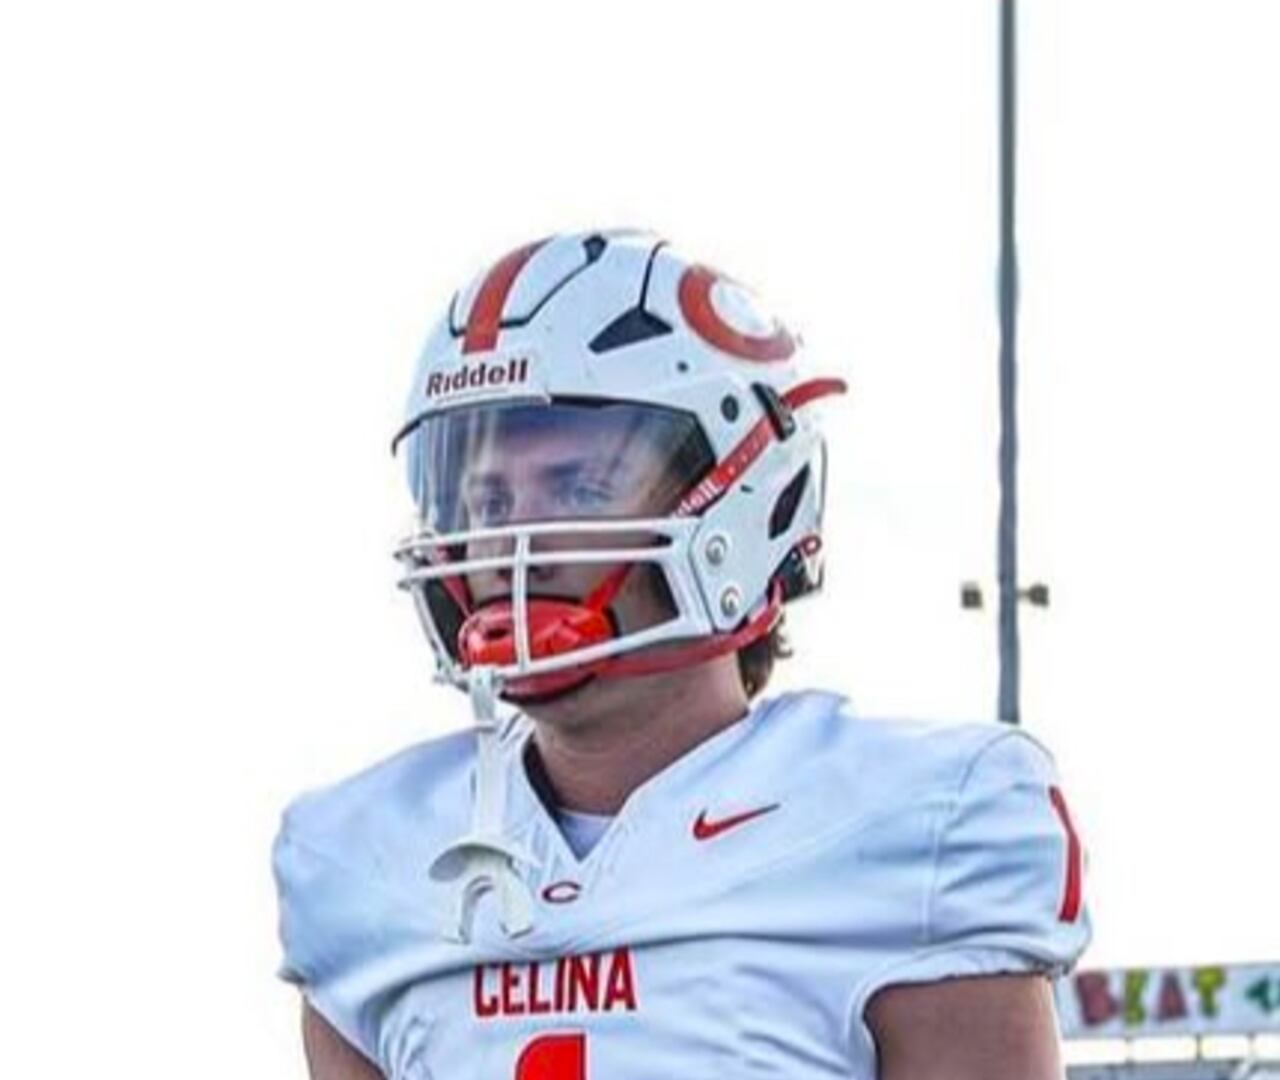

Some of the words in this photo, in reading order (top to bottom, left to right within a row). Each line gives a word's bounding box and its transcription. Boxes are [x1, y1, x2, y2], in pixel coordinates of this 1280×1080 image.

[426, 358, 529, 398] Riddell
[541, 880, 583, 905] C
[473, 943, 638, 1018] CELINA
[1074, 965, 1227, 1027] BEAT
